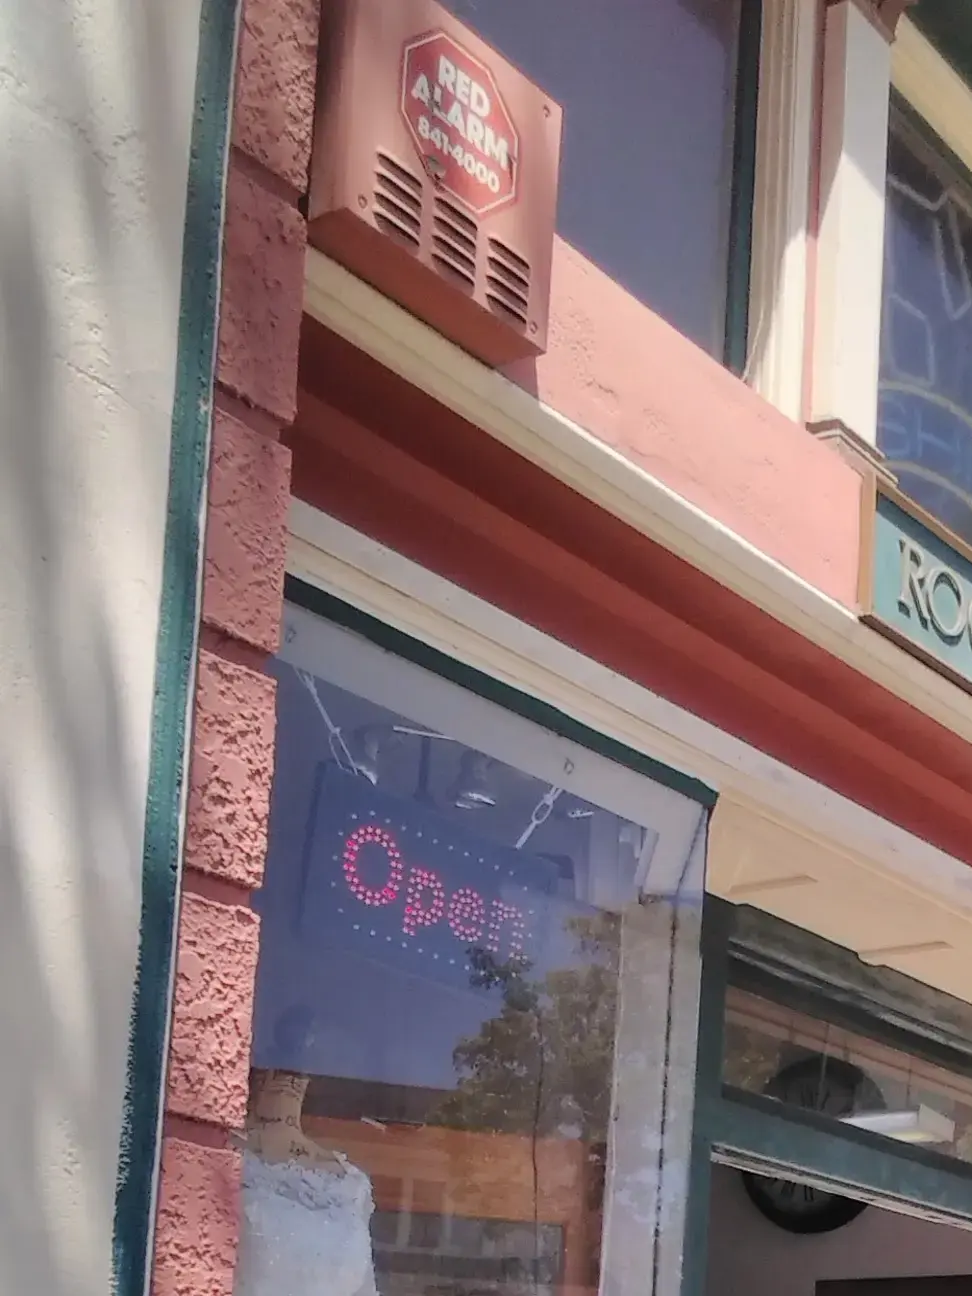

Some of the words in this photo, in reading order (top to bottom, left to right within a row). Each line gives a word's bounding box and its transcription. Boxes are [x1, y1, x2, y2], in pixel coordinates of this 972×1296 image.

[411, 73, 509, 171] ALARM
[439, 55, 490, 118] RED
[418, 115, 500, 193] 841-4000
[342, 825, 528, 962] Open
